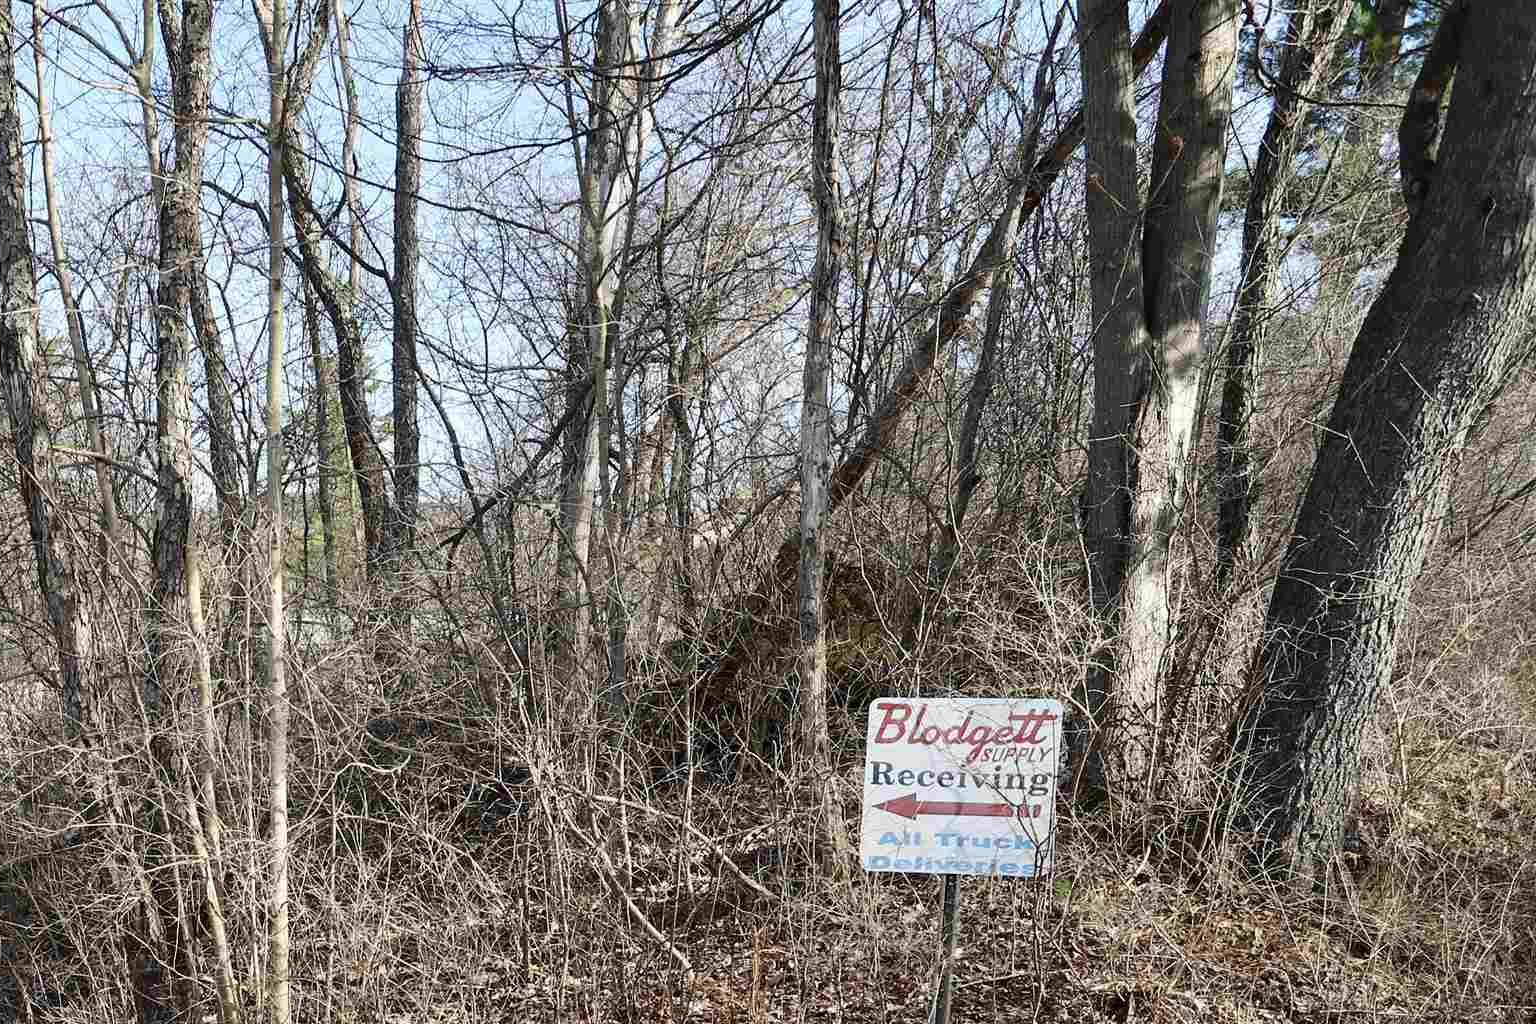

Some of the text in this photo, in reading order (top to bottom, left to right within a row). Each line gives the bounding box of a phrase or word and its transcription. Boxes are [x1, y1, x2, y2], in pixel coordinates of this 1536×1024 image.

[875, 703, 1057, 766] Blodgett
[981, 747, 1052, 763] SUPPLY
[870, 761, 1049, 796] Receiving
[879, 831, 1034, 849] All Truck
[865, 855, 1036, 874] Deliveries
